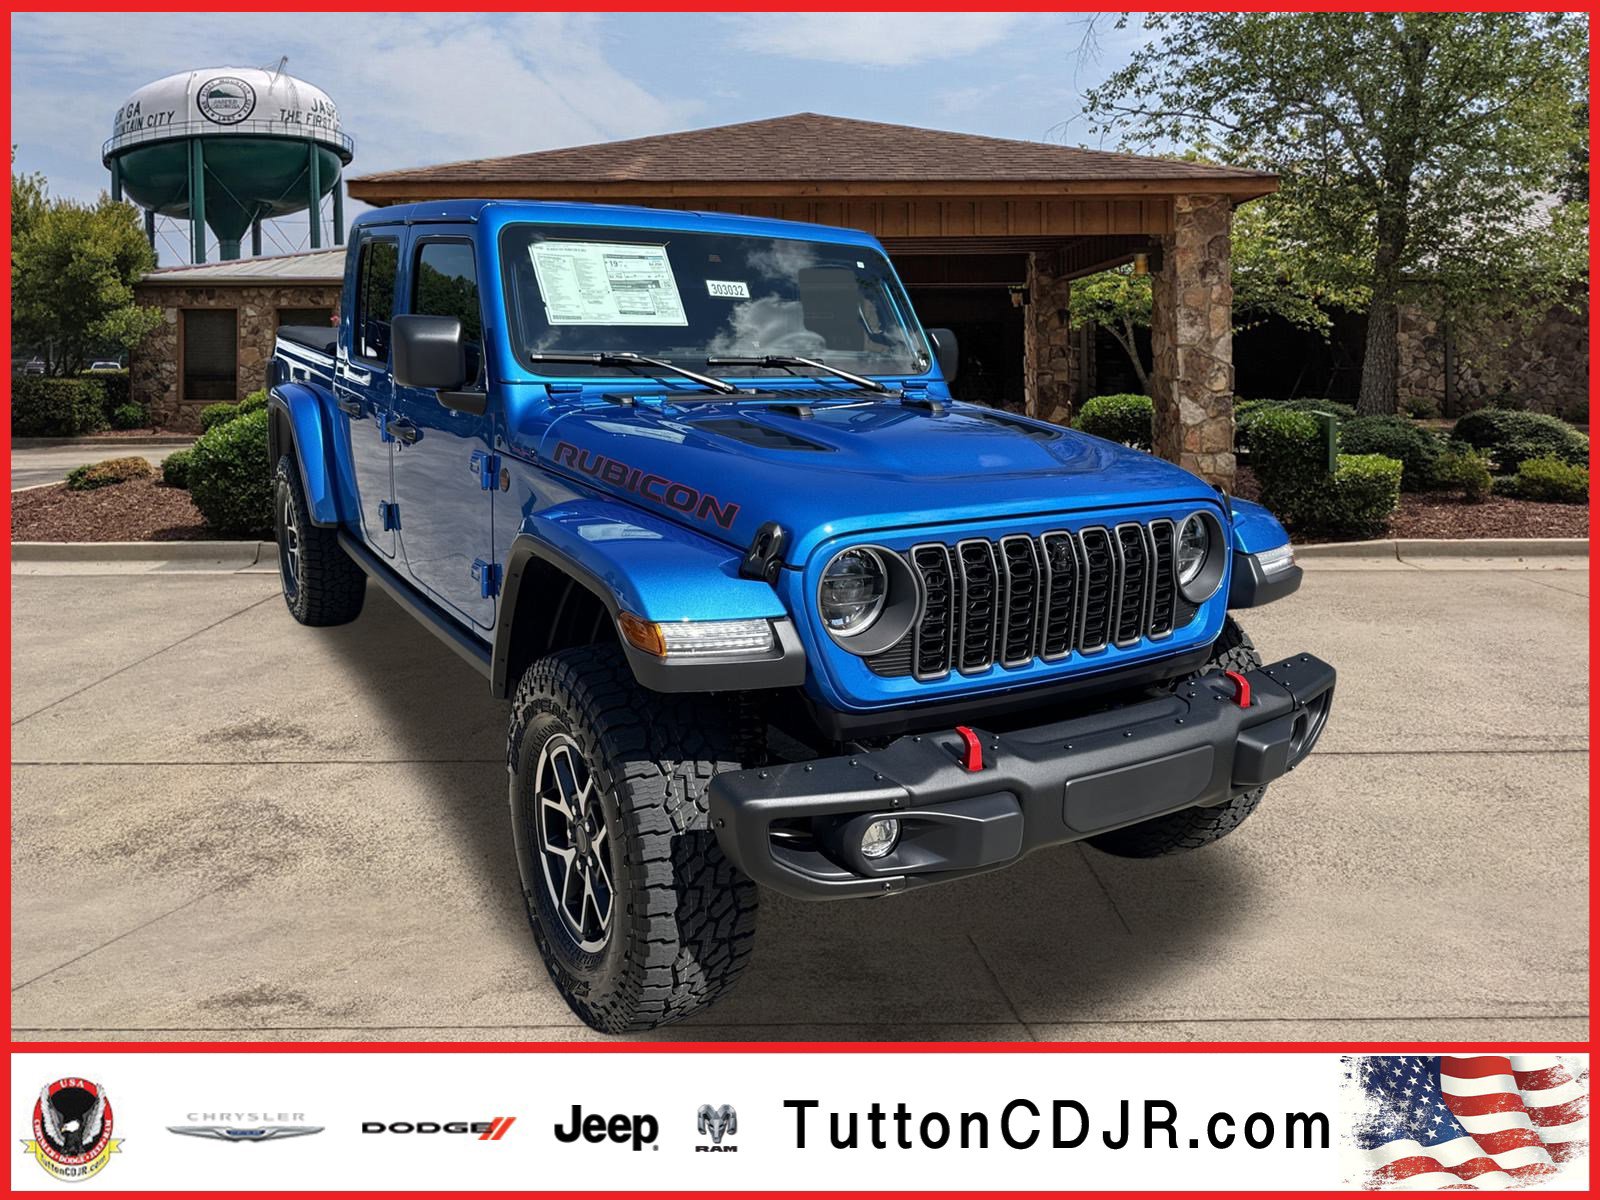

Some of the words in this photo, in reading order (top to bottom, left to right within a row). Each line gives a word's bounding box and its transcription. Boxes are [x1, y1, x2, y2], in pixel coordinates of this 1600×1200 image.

[126, 100, 141, 119] GA
[279, 108, 302, 124] THE
[146, 110, 175, 128] CITY
[711, 283, 745, 296] 303032
[552, 439, 741, 531] RUBICON
